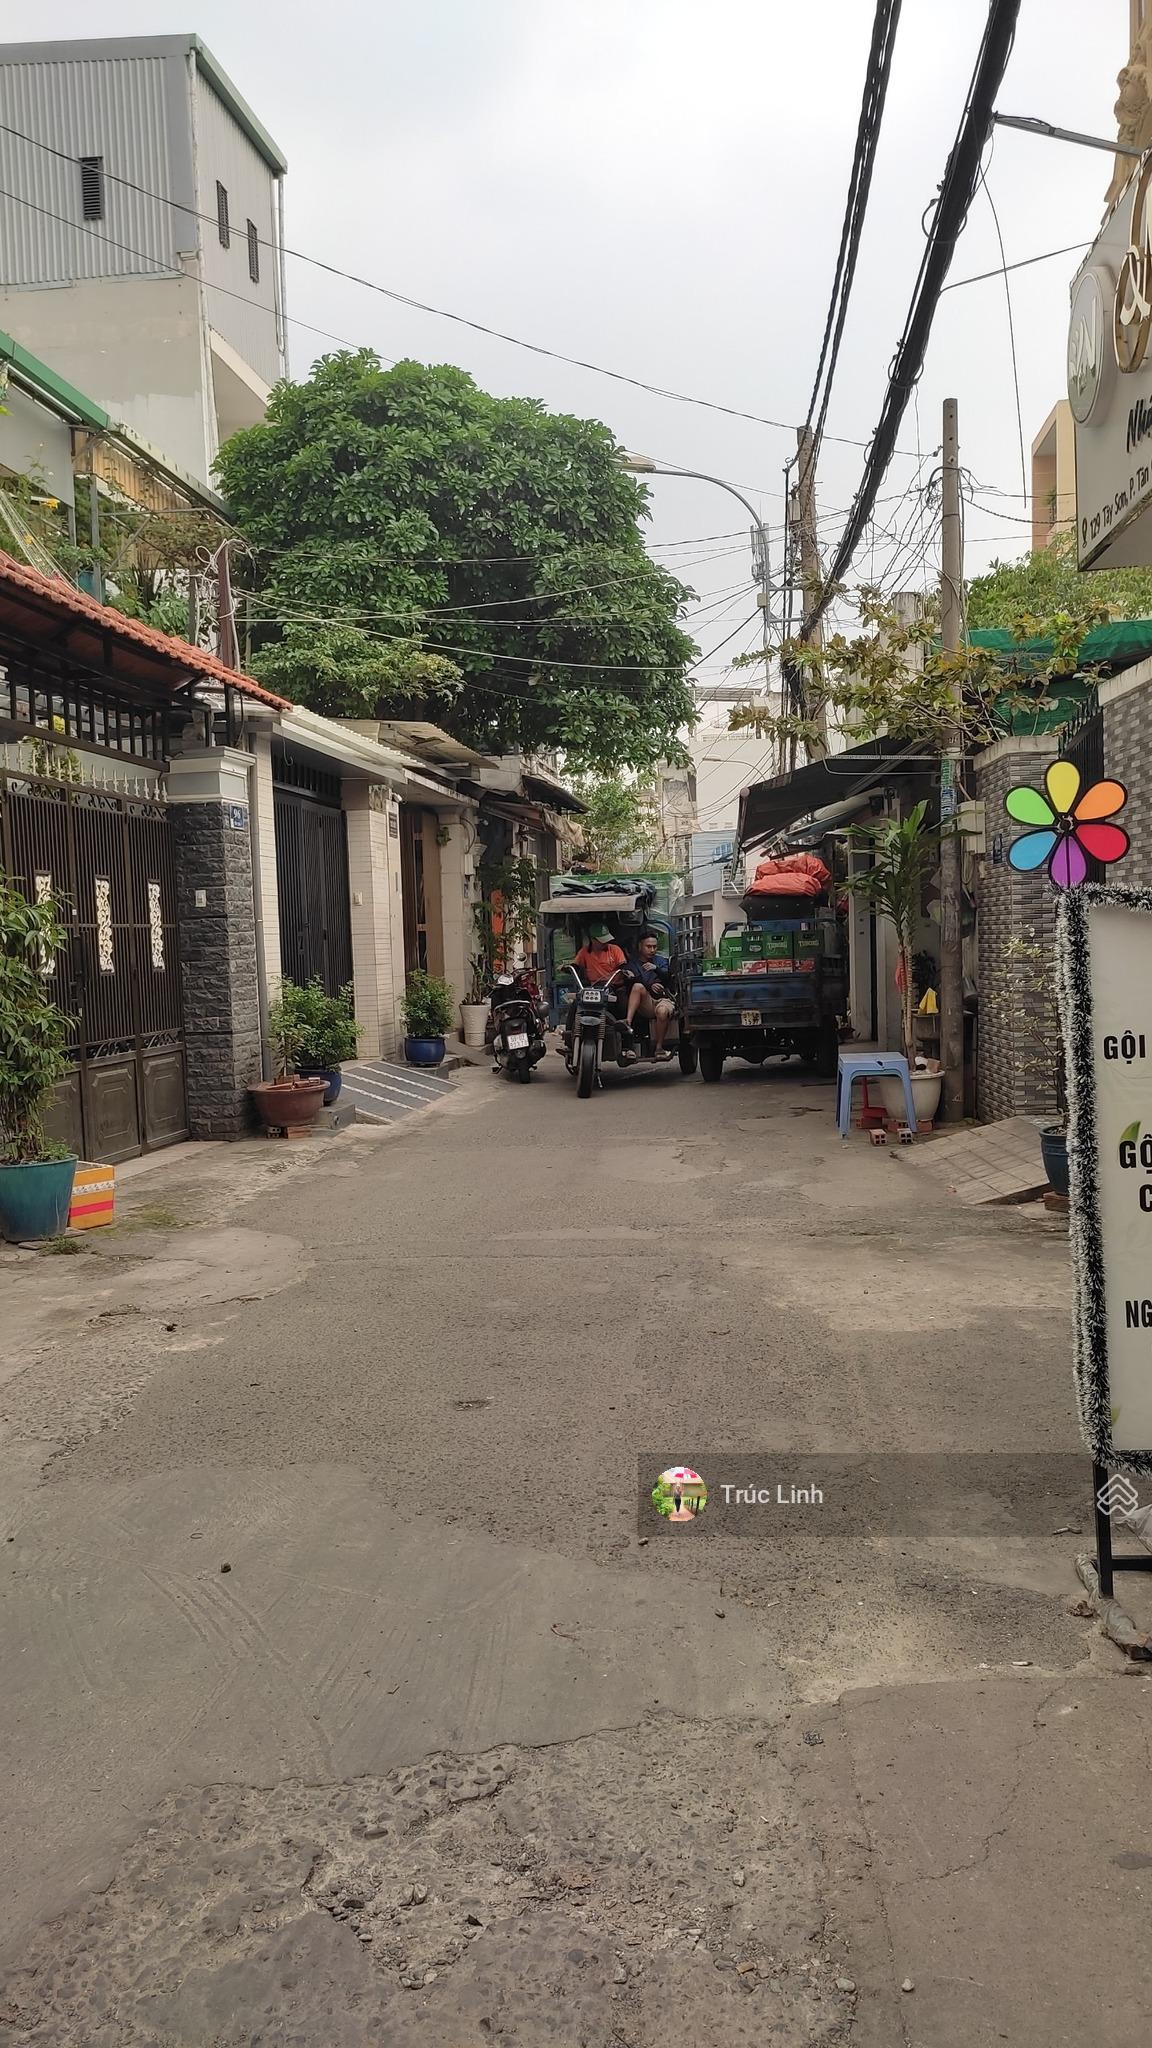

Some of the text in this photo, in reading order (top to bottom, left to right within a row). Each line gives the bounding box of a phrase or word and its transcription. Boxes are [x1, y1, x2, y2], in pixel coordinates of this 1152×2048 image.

[1090, 512, 1101, 540] 129
[1129, 477, 1136, 501] P.
[1103, 1029, 1146, 1065] GỘI
